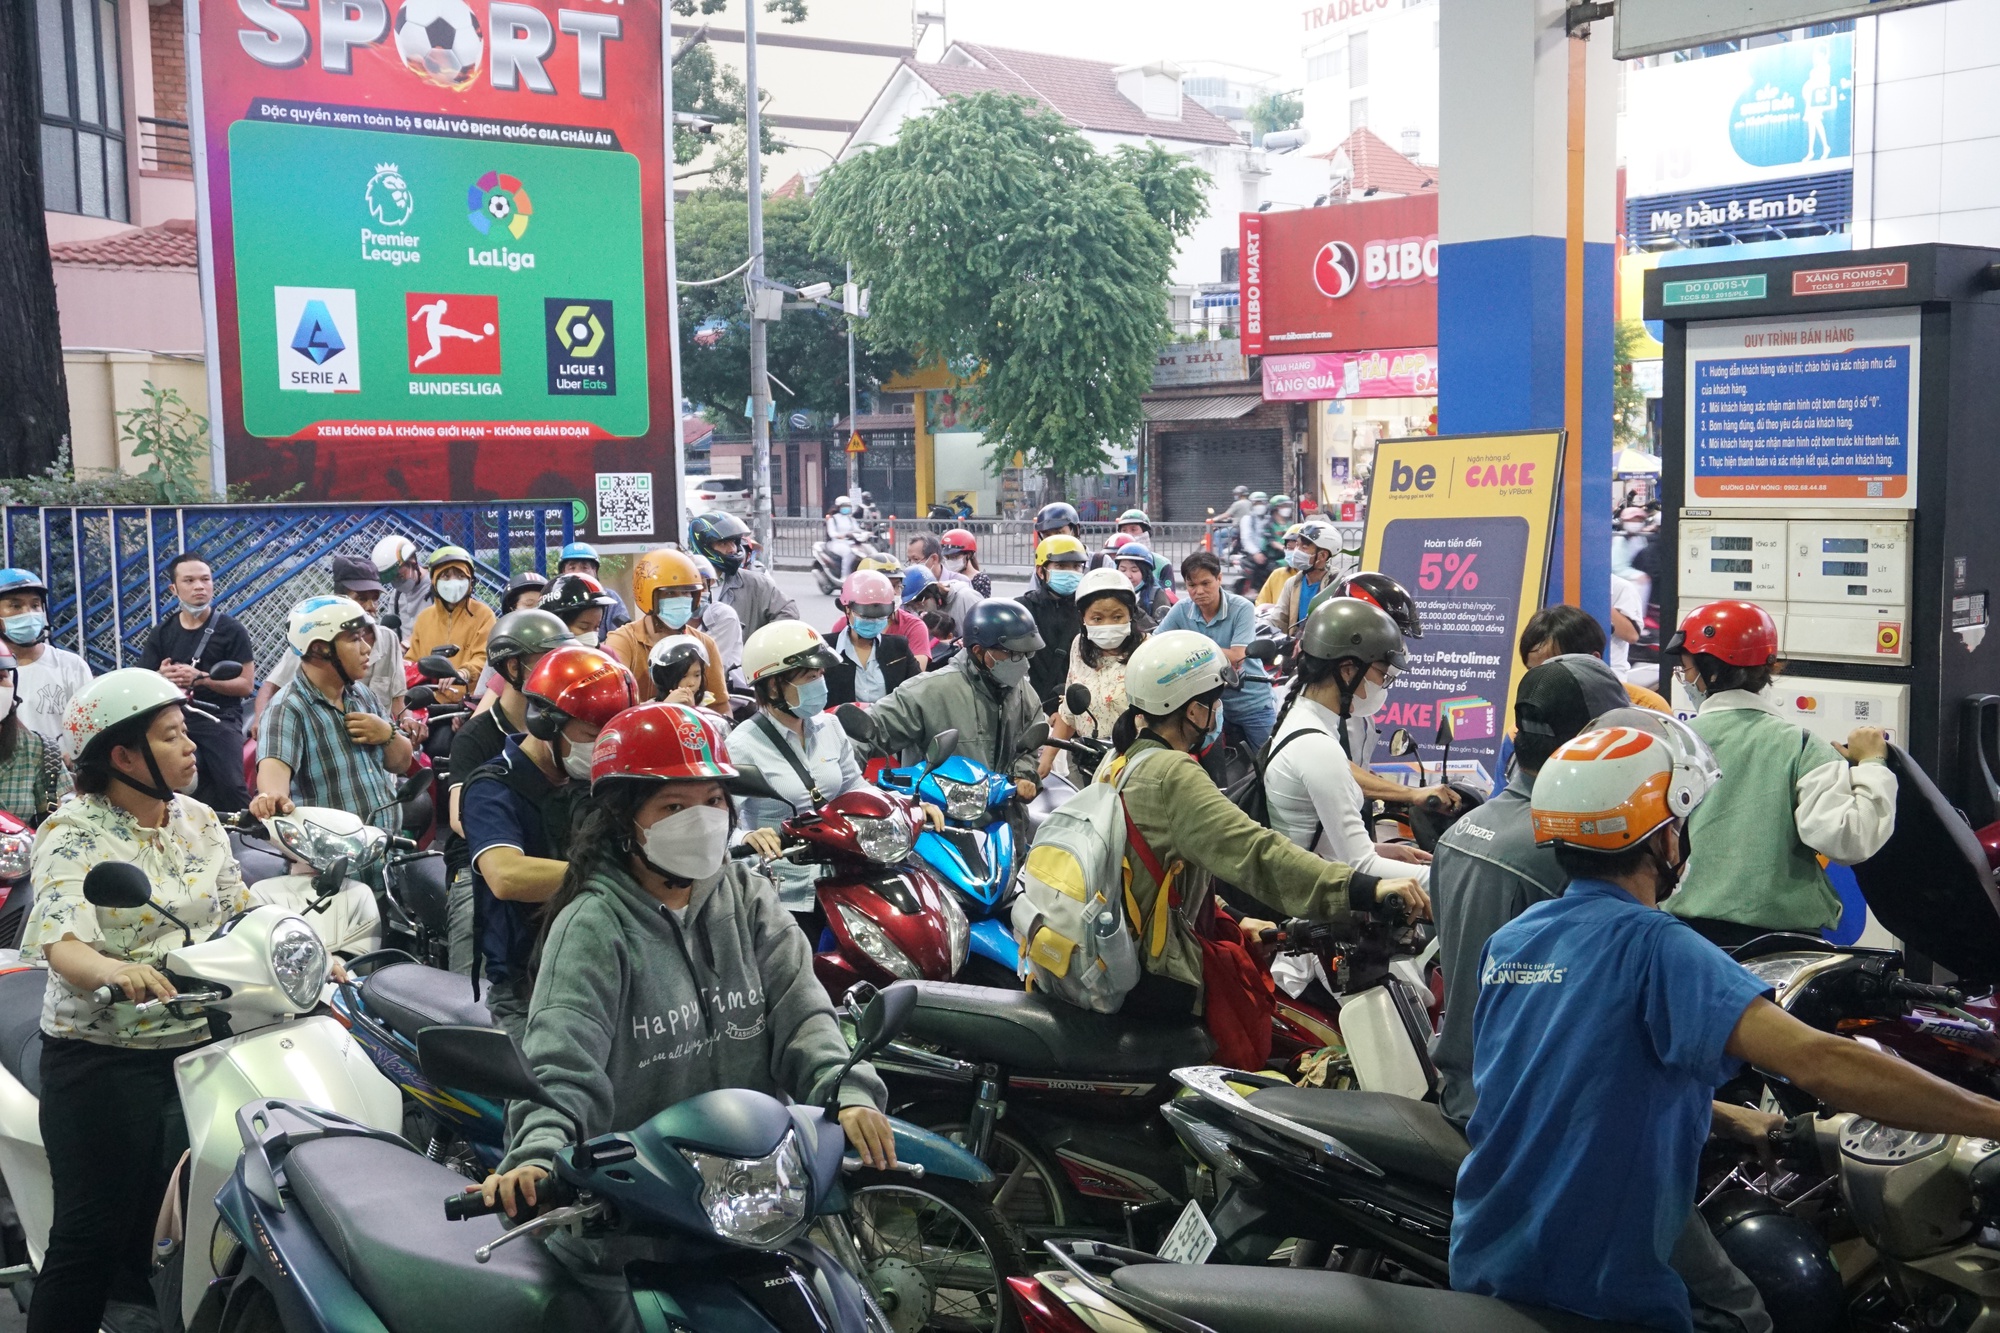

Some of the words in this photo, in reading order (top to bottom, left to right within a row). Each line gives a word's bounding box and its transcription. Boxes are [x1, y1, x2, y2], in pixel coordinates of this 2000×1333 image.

[261, 104, 287, 119] Đặc
[290, 107, 331, 123] quyền
[334, 111, 361, 123] xem
[363, 112, 392, 126] toàn
[395, 116, 411, 131] bộ
[414, 117, 422, 129] 5
[424, 116, 449, 131] GIẢI
[450, 119, 469, 133] VÔ
[470, 122, 500, 138] ĐỊCH
[502, 124, 537, 139] QUỐC
[538, 128, 559, 141] GIA
[560, 129, 594, 144] CHÂU
[595, 131, 611, 145] ÂU
[1651, 211, 1682, 235] Mẹ
[1686, 200, 1725, 228] bầu
[1728, 200, 1745, 222] &
[1748, 199, 1784, 220] Em
[1788, 190, 1818, 216] bé
[361, 227, 420, 248] Premier
[361, 244, 421, 267] League
[468, 247, 536, 271] LaLiga
[1247, 230, 1260, 283] MART
[1365, 239, 1438, 283] BIBO
[1806, 271, 1839, 284] XĂNG
[1842, 268, 1895, 281] RON95-V
[1685, 284, 1701, 293] DO
[1812, 283, 1833, 291] TCCS
[1851, 279, 1888, 288] 2015/PLX
[1247, 286, 1261, 334] BIBO
[1268, 332, 1333, 342] www.bibomart.com
[1744, 334, 1764, 348] QUY
[1767, 329, 1797, 346] TRÌNH
[1801, 328, 1821, 345] BÁN
[1825, 328, 1854, 343] HÀNG
[559, 364, 596, 376] LIGUE
[597, 365, 604, 376] 1
[1271, 363, 1287, 373] MUA
[1288, 361, 1311, 372] HÀNG
[1390, 355, 1427, 376] APP
[1741, 363, 1759, 376] khách
[1760, 363, 1775, 377] hàng
[1776, 362, 1787, 373] vào
[1805, 360, 1819, 372] chào
[1821, 358, 1831, 371] hỏi
[1832, 359, 1839, 371] và
[1840, 358, 1852, 370] xác
[1853, 357, 1869, 372] nhận
[1870, 357, 1883, 369] nhu
[1884, 355, 1896, 369] cầu
[291, 371, 334, 385] SERIE
[337, 372, 348, 385] A
[556, 378, 581, 390] Uber
[583, 378, 607, 390] Eats
[1270, 378, 1304, 397] TẶNG
[1306, 371, 1335, 391] QUÀ
[409, 381, 503, 396] BUNDESLIGA
[1701, 383, 1712, 395] của
[1713, 383, 1730, 395] khách
[1731, 382, 1748, 397] hàng.
[318, 426, 342, 437] XEM
[344, 424, 376, 437] BÓNG
[378, 424, 394, 437] ĐÁ
[395, 424, 435, 437] KHÔNG
[437, 424, 459, 437] GIỚI
[461, 425, 484, 439] HẠN
[494, 424, 532, 437] KHÔNG
[533, 424, 558, 437] GIÁN
[560, 425, 589, 439] ĐOẠN
[1467, 455, 1484, 463] Ngân
[1485, 454, 1501, 463] hàng
[1502, 452, 1511, 461] số
[1390, 459, 1436, 492] be
[1465, 462, 1536, 488] CAKE
[1499, 487, 1508, 496] by
[1508, 487, 1533, 496] VPBank
[1424, 538, 1446, 548] Hoàn
[1447, 537, 1464, 548] tiền
[1465, 537, 1482, 548] đến
[1418, 552, 1479, 591] 5%
[1419, 612, 1456, 620] 25.000.000
[1495, 613, 1505, 621] và
[1421, 623, 1433, 631] ách
[1434, 623, 1441, 631] là
[1442, 623, 1484, 632] 300.000.000
[1485, 623, 1504, 633] đồng
[1424, 653, 1436, 665] tại
[1436, 651, 1501, 665] Petrolimex
[1411, 666, 1428, 676] toán
[1432, 667, 1458, 679] không
[1459, 667, 1476, 679] tiền
[1477, 669, 1496, 681] mặt
[1394, 679, 1409, 688] thẻ
[1409, 680, 1431, 691] ngân
[1432, 680, 1455, 693] hàng
[1456, 681, 1468, 691] số
[1372, 702, 1433, 728] CAKE
[1486, 707, 1494, 735] CAKE
[1486, 747, 1495, 755] be
[1466, 823, 1496, 842] mazda
[632, 1000, 700, 1040] Happy
[734, 1025, 761, 1037] FASHION
[668, 1045, 682, 1060] all
[1047, 1081, 1096, 1092] HONDA
